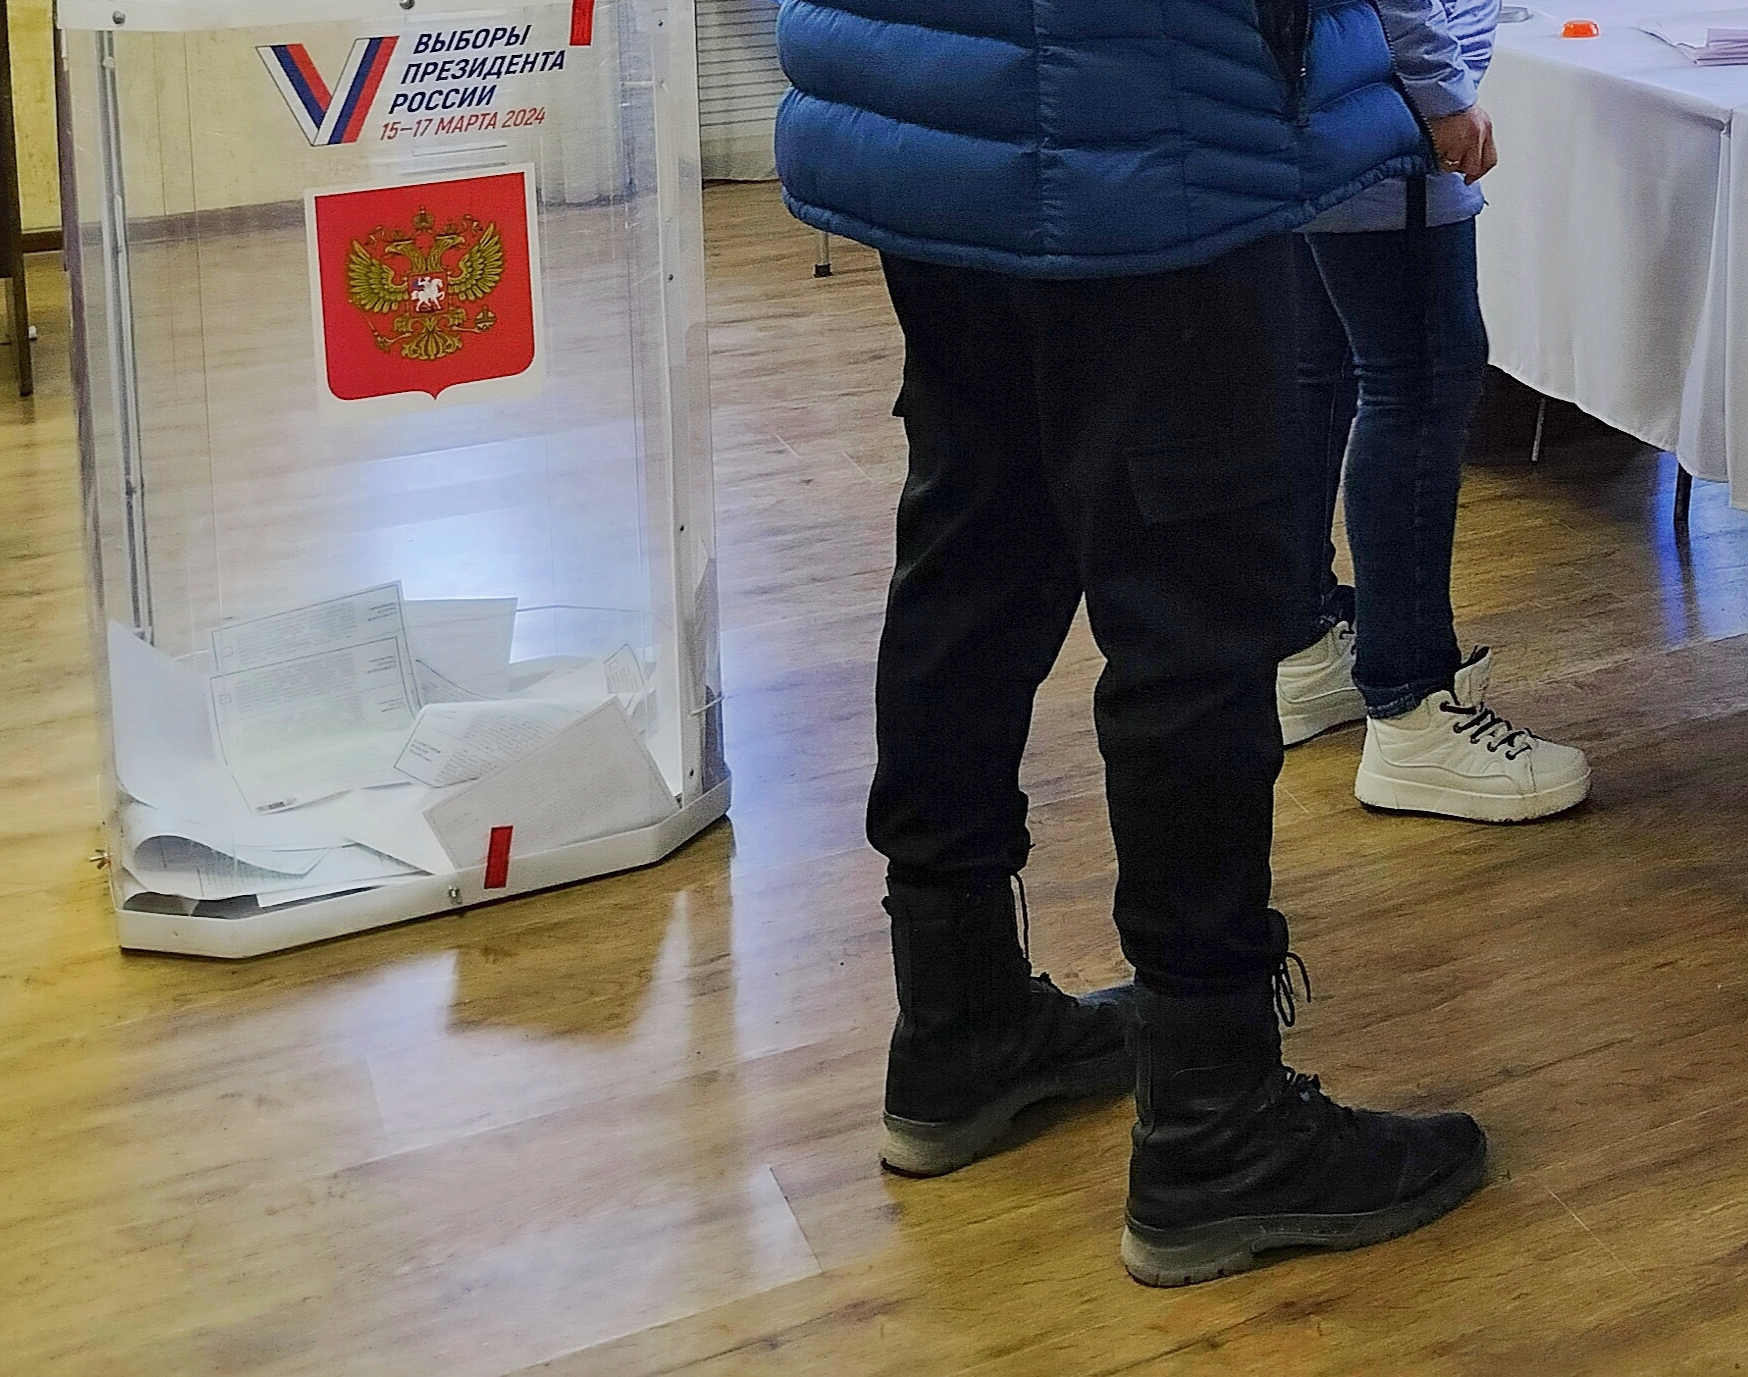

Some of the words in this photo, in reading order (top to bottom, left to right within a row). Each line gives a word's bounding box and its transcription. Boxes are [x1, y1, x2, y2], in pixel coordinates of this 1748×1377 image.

[413, 24, 532, 55] ВЫБОРЫ
[400, 50, 566, 85] ПРЕЗИДЕНТА
[388, 84, 498, 115] РОССИИ
[434, 111, 498, 135] МАРТА
[501, 107, 546, 128] 2024
